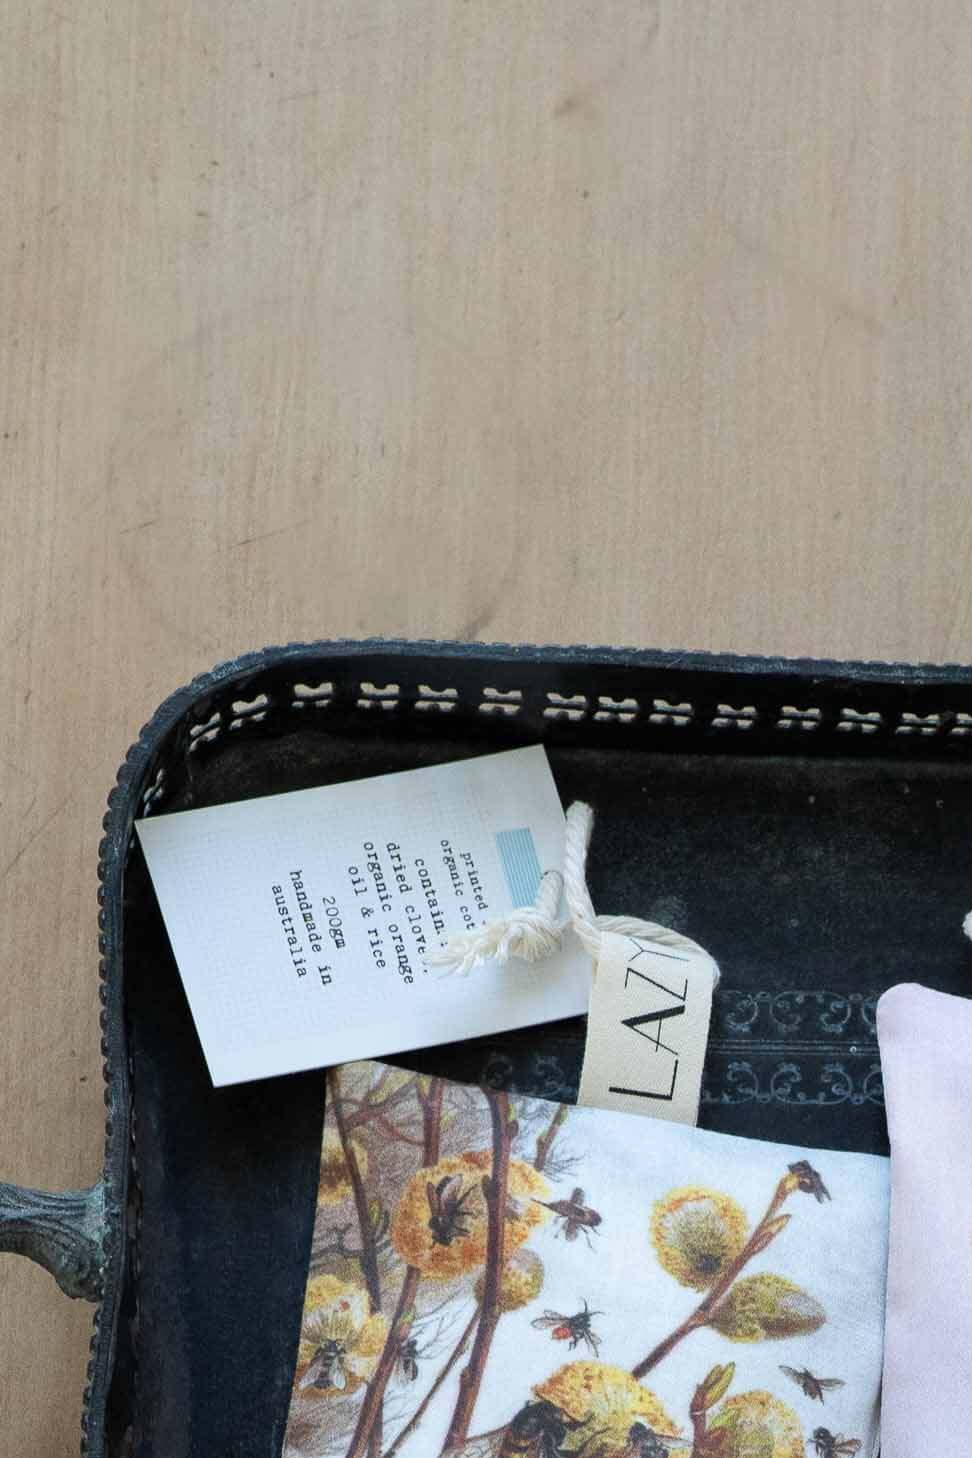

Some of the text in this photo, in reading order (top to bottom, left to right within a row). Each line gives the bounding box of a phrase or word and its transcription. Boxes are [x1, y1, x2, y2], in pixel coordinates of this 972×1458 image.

[363, 841, 414, 984] organic orange
[386, 842, 413, 893] dried
[440, 839, 464, 897] organic
[459, 852, 489, 911] printed
[271, 884, 307, 977] australia
[290, 869, 333, 985] handmade in
[322, 896, 347, 949] 200gm
[348, 866, 386, 969] oil & rice
[608, 938, 690, 1101] LAZY
